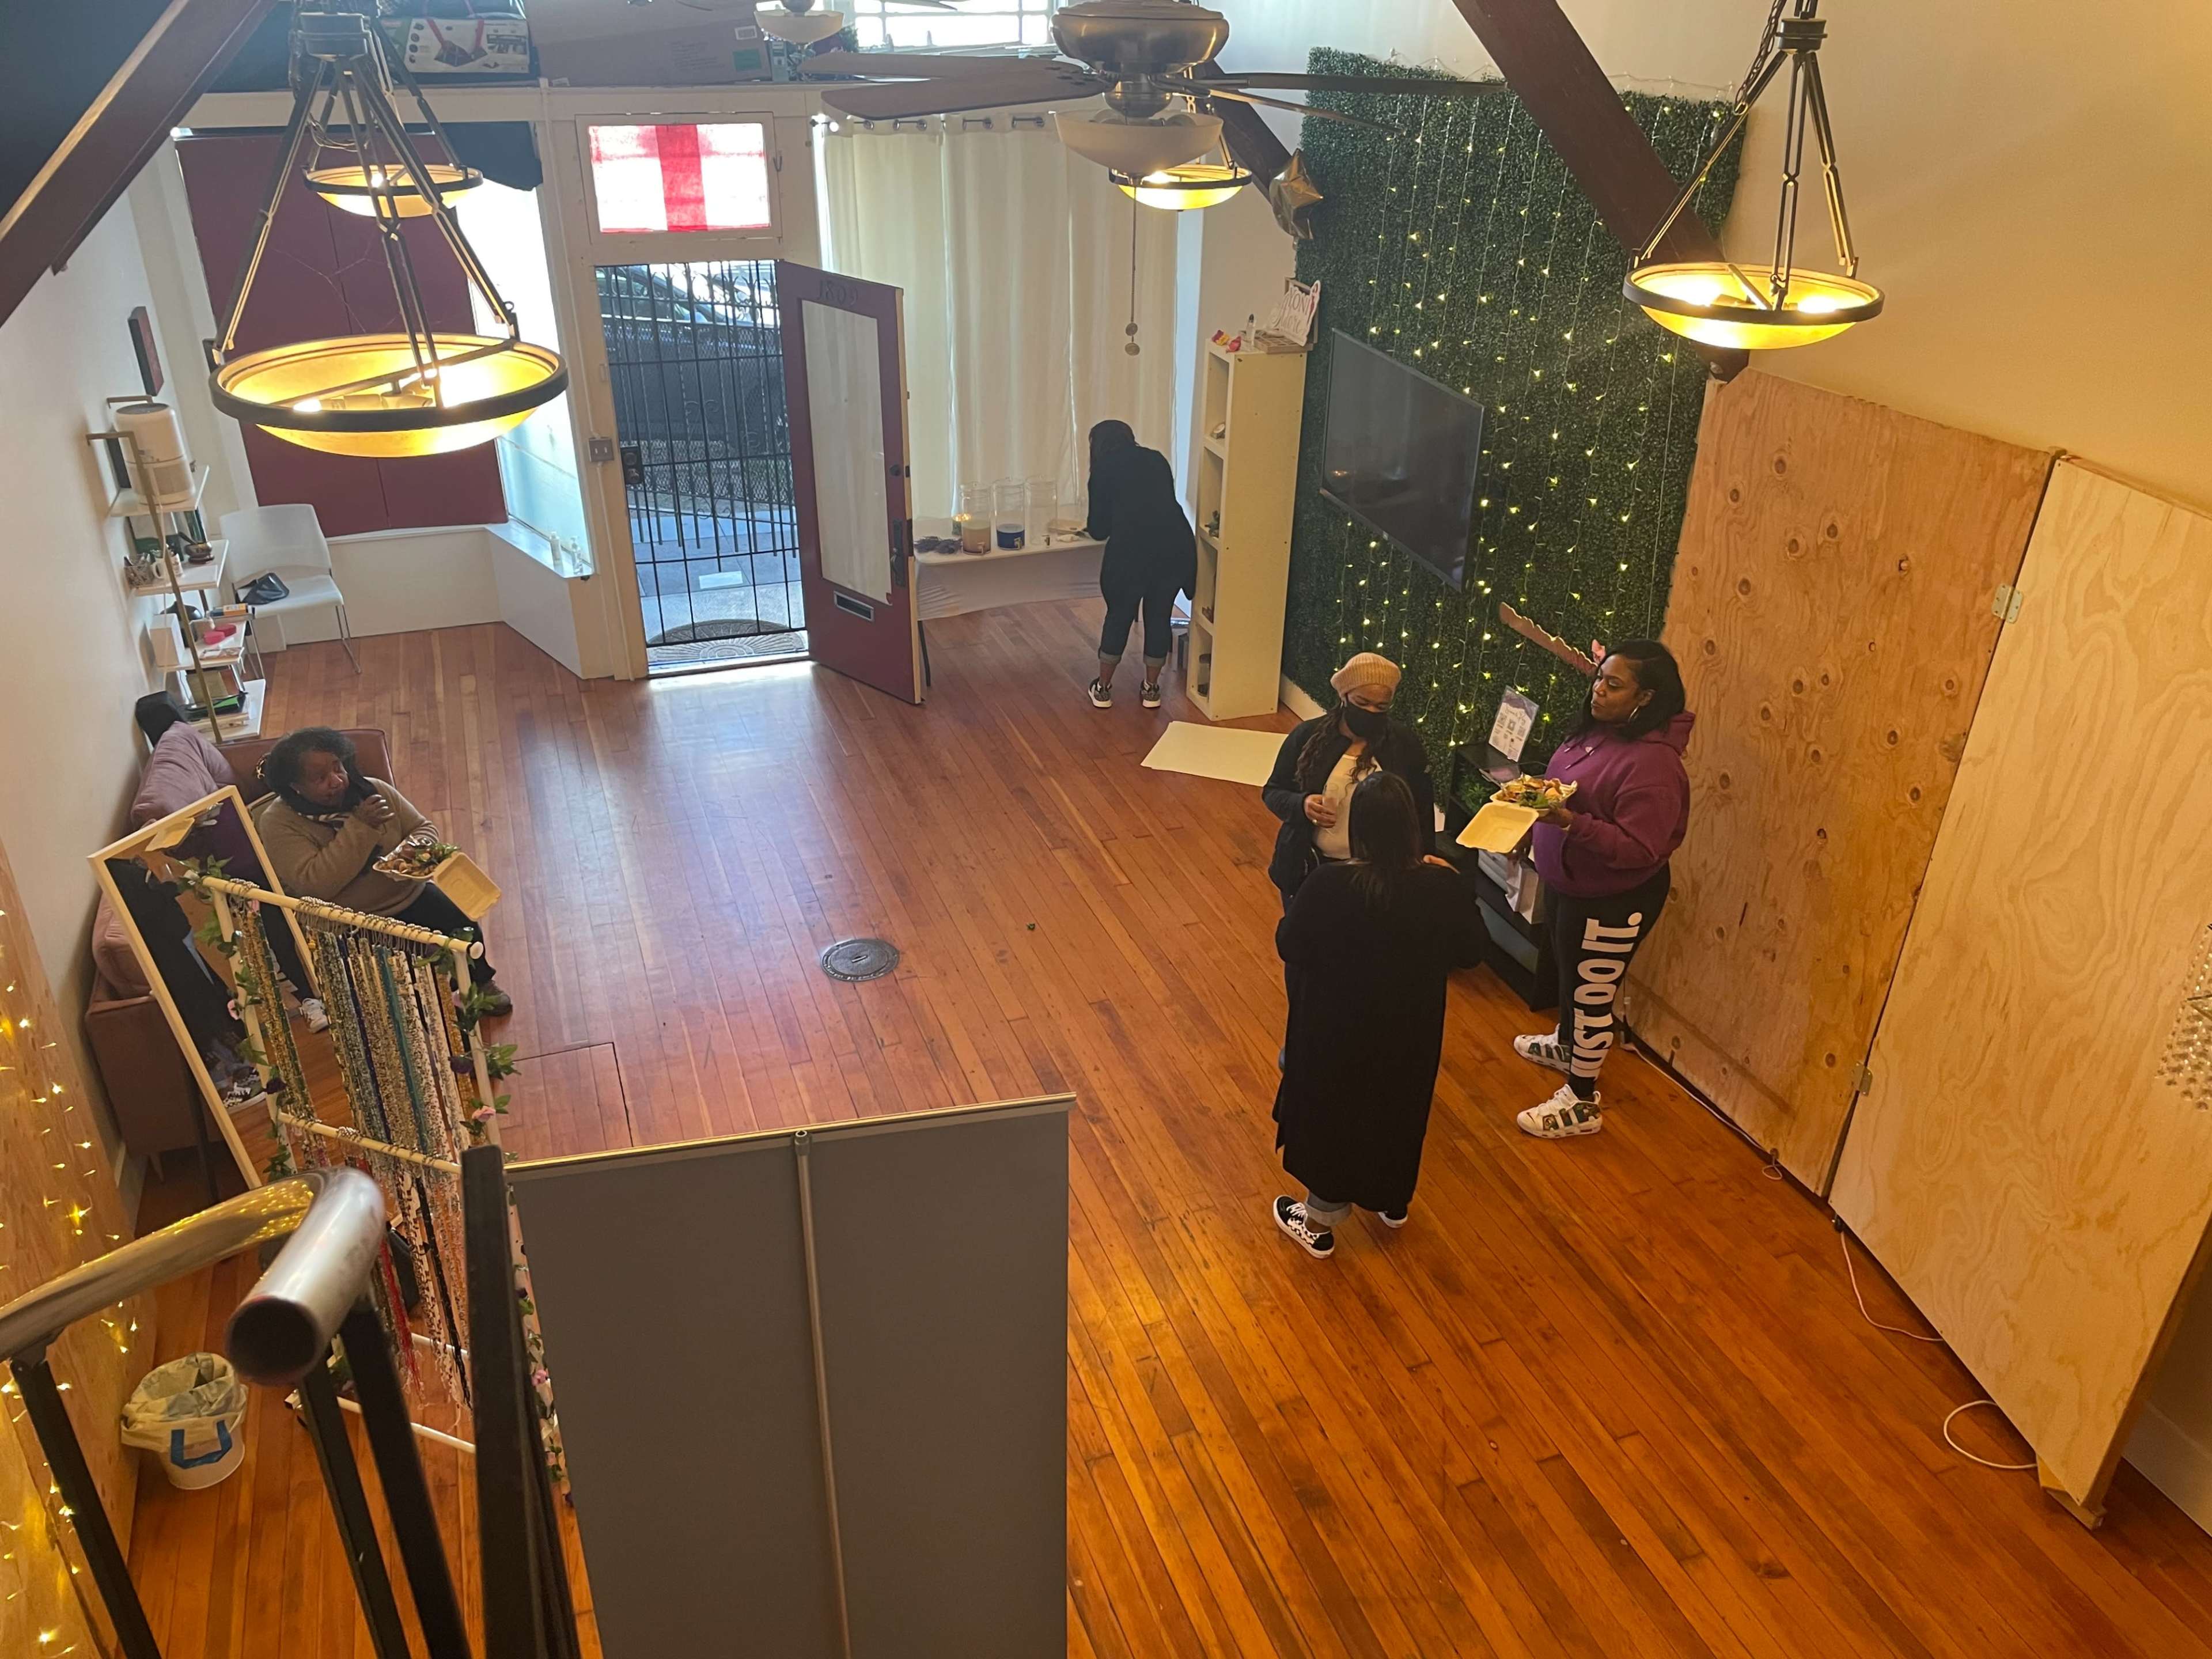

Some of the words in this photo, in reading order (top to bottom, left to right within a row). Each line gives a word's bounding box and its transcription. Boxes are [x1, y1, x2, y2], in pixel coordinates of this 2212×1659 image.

[1582, 912, 1642, 953] IT.
[1574, 959, 1626, 1005] DO
[1570, 1008, 1613, 1081] JUST
